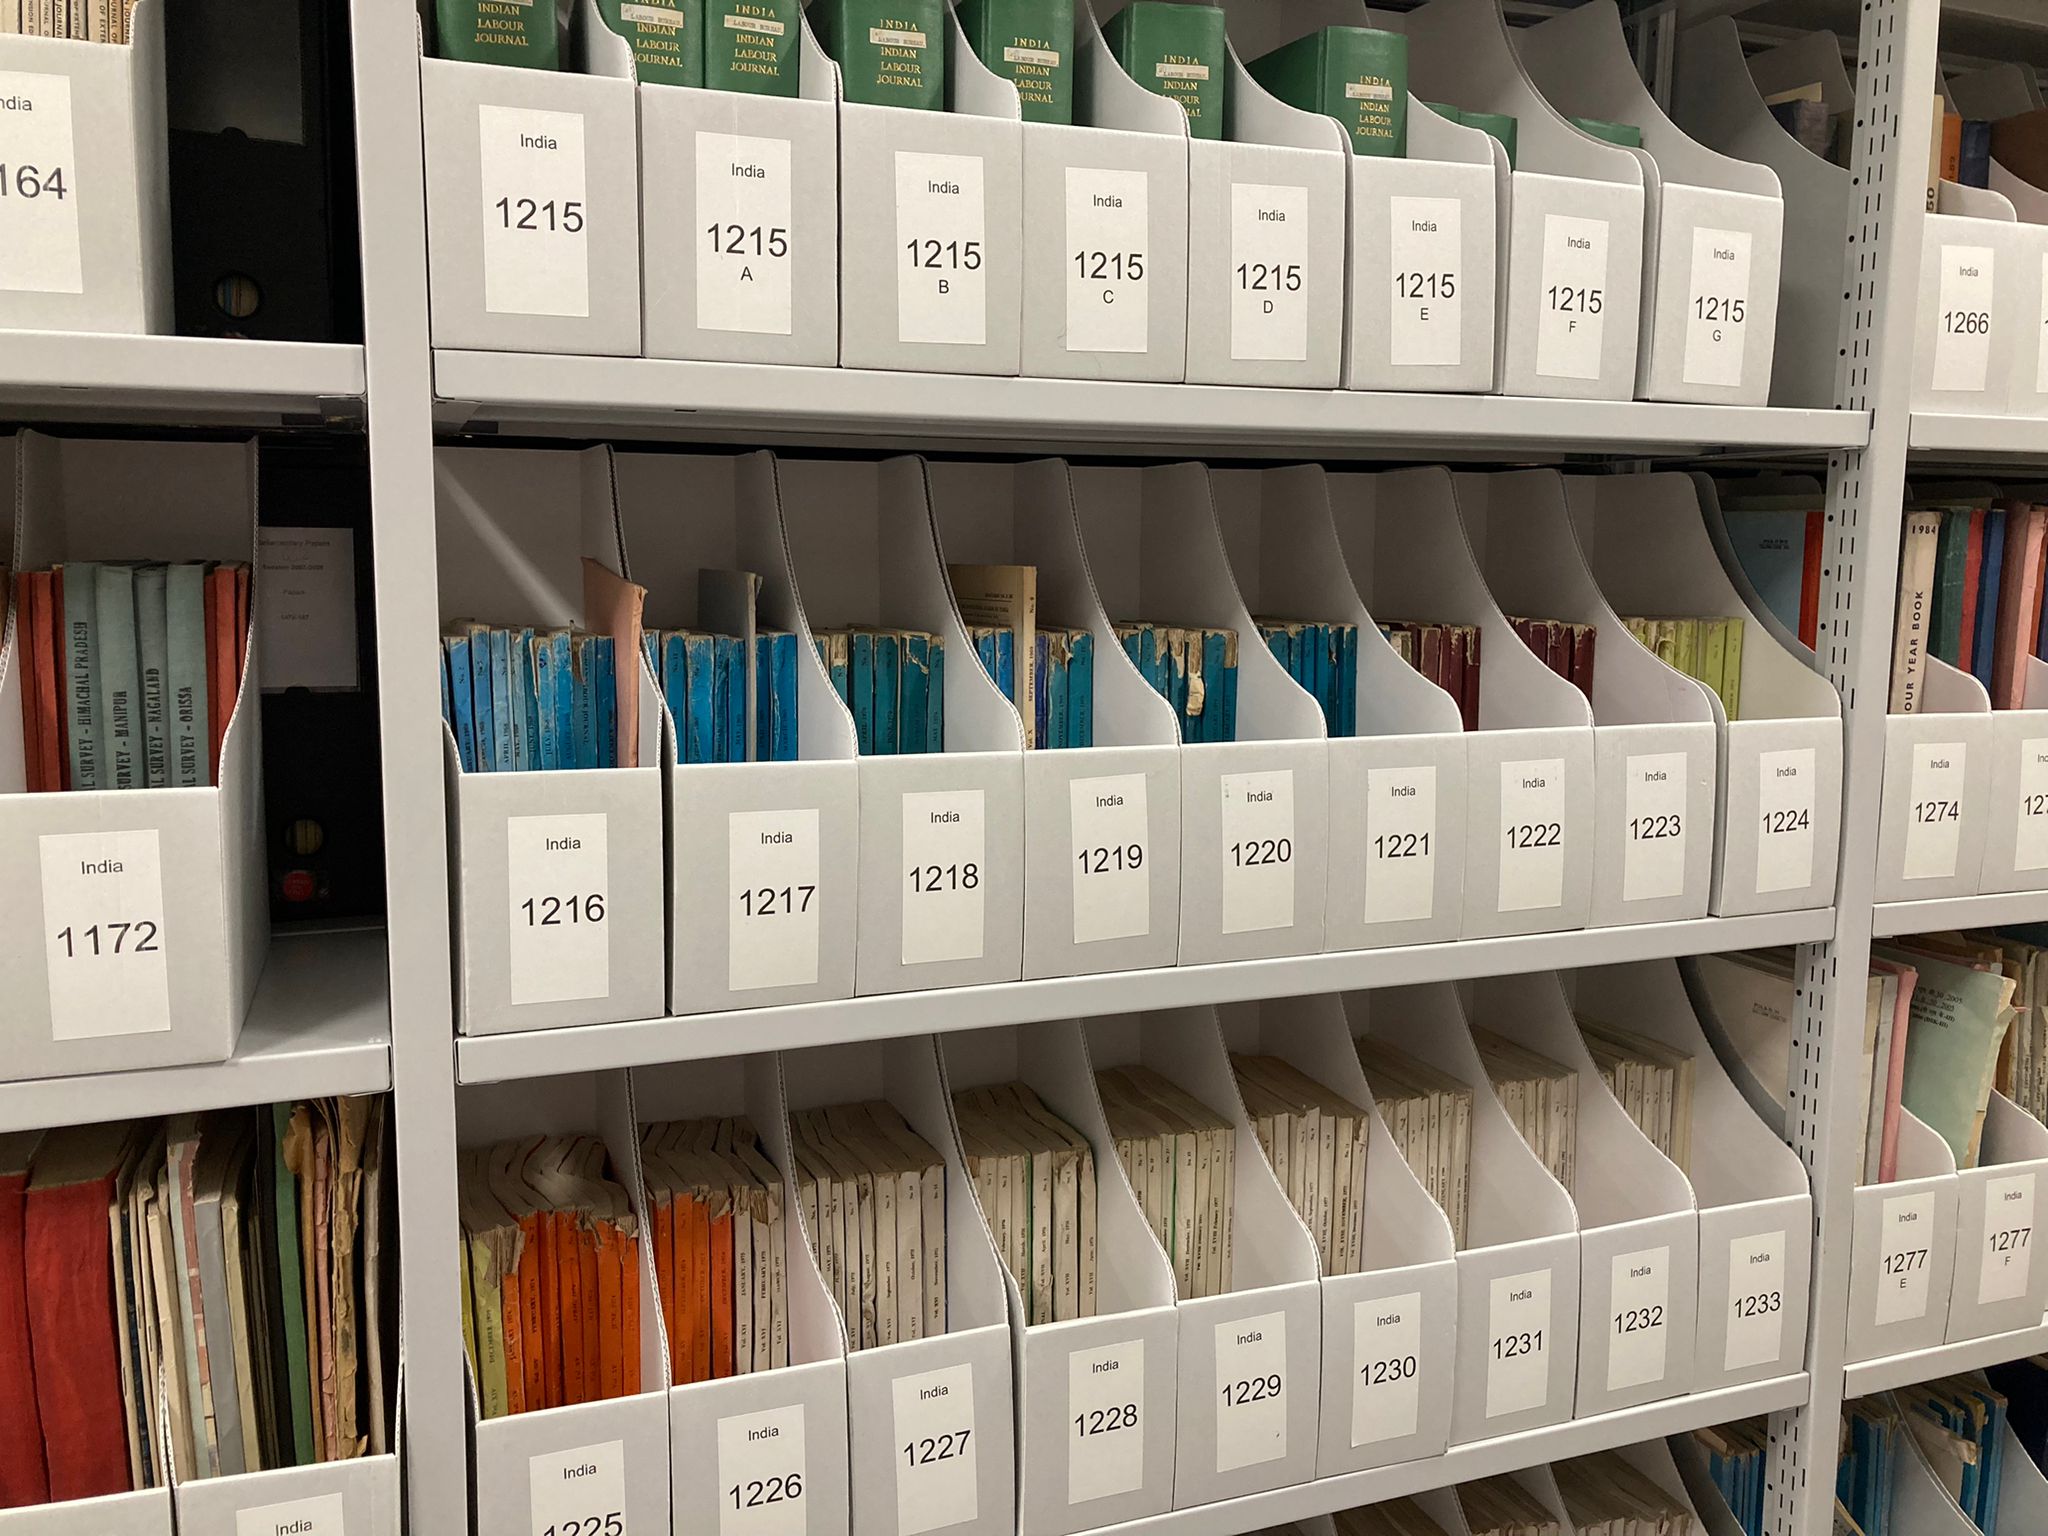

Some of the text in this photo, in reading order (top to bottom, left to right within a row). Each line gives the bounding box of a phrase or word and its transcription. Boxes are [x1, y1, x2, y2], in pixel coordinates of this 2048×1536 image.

[100, 5, 106, 16] OF
[478, 3, 520, 16] INDIAN
[736, 4, 776, 18] INDIA
[477, 18, 524, 32] LABOUR
[637, 23, 676, 36] INDIAN
[880, 19, 918, 32] INDIA
[474, 32, 528, 46] JOURNAL
[636, 39, 680, 52] LABOUR
[736, 34, 774, 48] INDIAN
[1014, 37, 1050, 49] INDIA
[734, 48, 777, 62] LABOUR
[880, 46, 916, 59] INDIAN
[1164, 54, 1200, 65] INDIA
[730, 62, 780, 76] JOURNAL
[880, 61, 921, 74] LABOUR
[1016, 64, 1050, 76] INDIAN
[876, 74, 923, 88] JOURNAL
[1014, 78, 1052, 90] LABOUR
[1164, 80, 1198, 91] INDIAN
[1360, 76, 1390, 87] INDIA
[0, 95, 33, 111] ndia
[1020, 92, 1054, 103] URNAL
[1360, 102, 1389, 112] INDIAN
[1360, 114, 1392, 126] LABOUR
[1355, 126, 1394, 138] JOURNAL
[520, 133, 558, 150] India
[731, 162, 765, 179] India
[0, 163, 68, 200] 164
[928, 180, 960, 195] India
[1093, 194, 1123, 208] India
[495, 196, 584, 233] 1215
[1258, 208, 1286, 222] India
[1412, 219, 1438, 233] India
[707, 222, 788, 258] 1215
[1567, 236, 1591, 250] India
[907, 238, 982, 270] 1215
[1713, 248, 1735, 261] India
[1074, 250, 1144, 281] 1215
[1959, 266, 1979, 278] India
[740, 265, 754, 282] A
[1237, 263, 1302, 292] 1215
[938, 279, 950, 294] B
[1396, 272, 1455, 299] 1215
[1102, 289, 1114, 304] C
[1548, 285, 1602, 314] 1215
[1263, 299, 1274, 314] D
[1695, 295, 1745, 323] 1215
[1420, 307, 1429, 321] E
[1568, 320, 1577, 333] F
[1944, 311, 1989, 335] 1266
[1712, 329, 1722, 342] G
[1912, 524, 1936, 536] 1984
[1904, 592, 1924, 711] OUR YEAR BOOK
[73, 622, 95, 777] SURVEY HIMACHAL PRADESH
[146, 668, 165, 774] SURVEY NAGALAND
[178, 686, 196, 774] SURVEY ORISSA
[112, 691, 132, 790] SURVEY MANIPUR
[1930, 759, 1950, 769] India
[1644, 770, 1667, 782] India
[1776, 767, 1797, 777] India
[1522, 777, 1546, 789] India
[1247, 791, 1273, 803] India
[1391, 785, 1416, 797] India
[1096, 795, 1124, 808] India
[2024, 794, 2048, 816] 12
[930, 811, 960, 824] India
[1915, 800, 1960, 823] 1274
[1630, 814, 1681, 841] 1223
[1762, 808, 1810, 834] 1224
[761, 831, 793, 845] India
[1507, 822, 1561, 849] 1222
[546, 837, 581, 851] India
[1374, 832, 1429, 859] 1221
[1078, 843, 1143, 875] 1219
[1231, 838, 1292, 867] 1220
[81, 859, 124, 875] India
[909, 863, 979, 893] 1218
[739, 885, 816, 917] 1217
[521, 893, 605, 927] 1216
[57, 920, 159, 958] 1172
[2004, 1191, 2023, 1201] India
[1898, 1212, 1918, 1223] India
[1989, 1227, 2033, 1253] 1277
[1749, 1253, 1770, 1264] India
[1883, 1248, 1929, 1275] 1277
[2004, 1255, 2011, 1266] F
[1630, 1266, 1652, 1278] India
[1899, 1277, 1907, 1289] E
[1510, 1290, 1533, 1302] India
[1734, 1291, 1781, 1319] 1233
[1376, 1314, 1401, 1327] India
[1614, 1305, 1663, 1334] 1232
[1237, 1332, 1263, 1345] India
[1493, 1329, 1542, 1360] 1231
[1092, 1360, 1119, 1374] India
[1360, 1355, 1417, 1387] 1230
[920, 1385, 949, 1401] India
[1222, 1374, 1282, 1407] 1229
[1074, 1403, 1138, 1437] 1228
[748, 1426, 779, 1442] India
[903, 1429, 971, 1467] 1227
[563, 1464, 597, 1480] India
[729, 1473, 803, 1510] 1226
[275, 1519, 313, 1536] India
[543, 1511, 623, 1536] 1225
